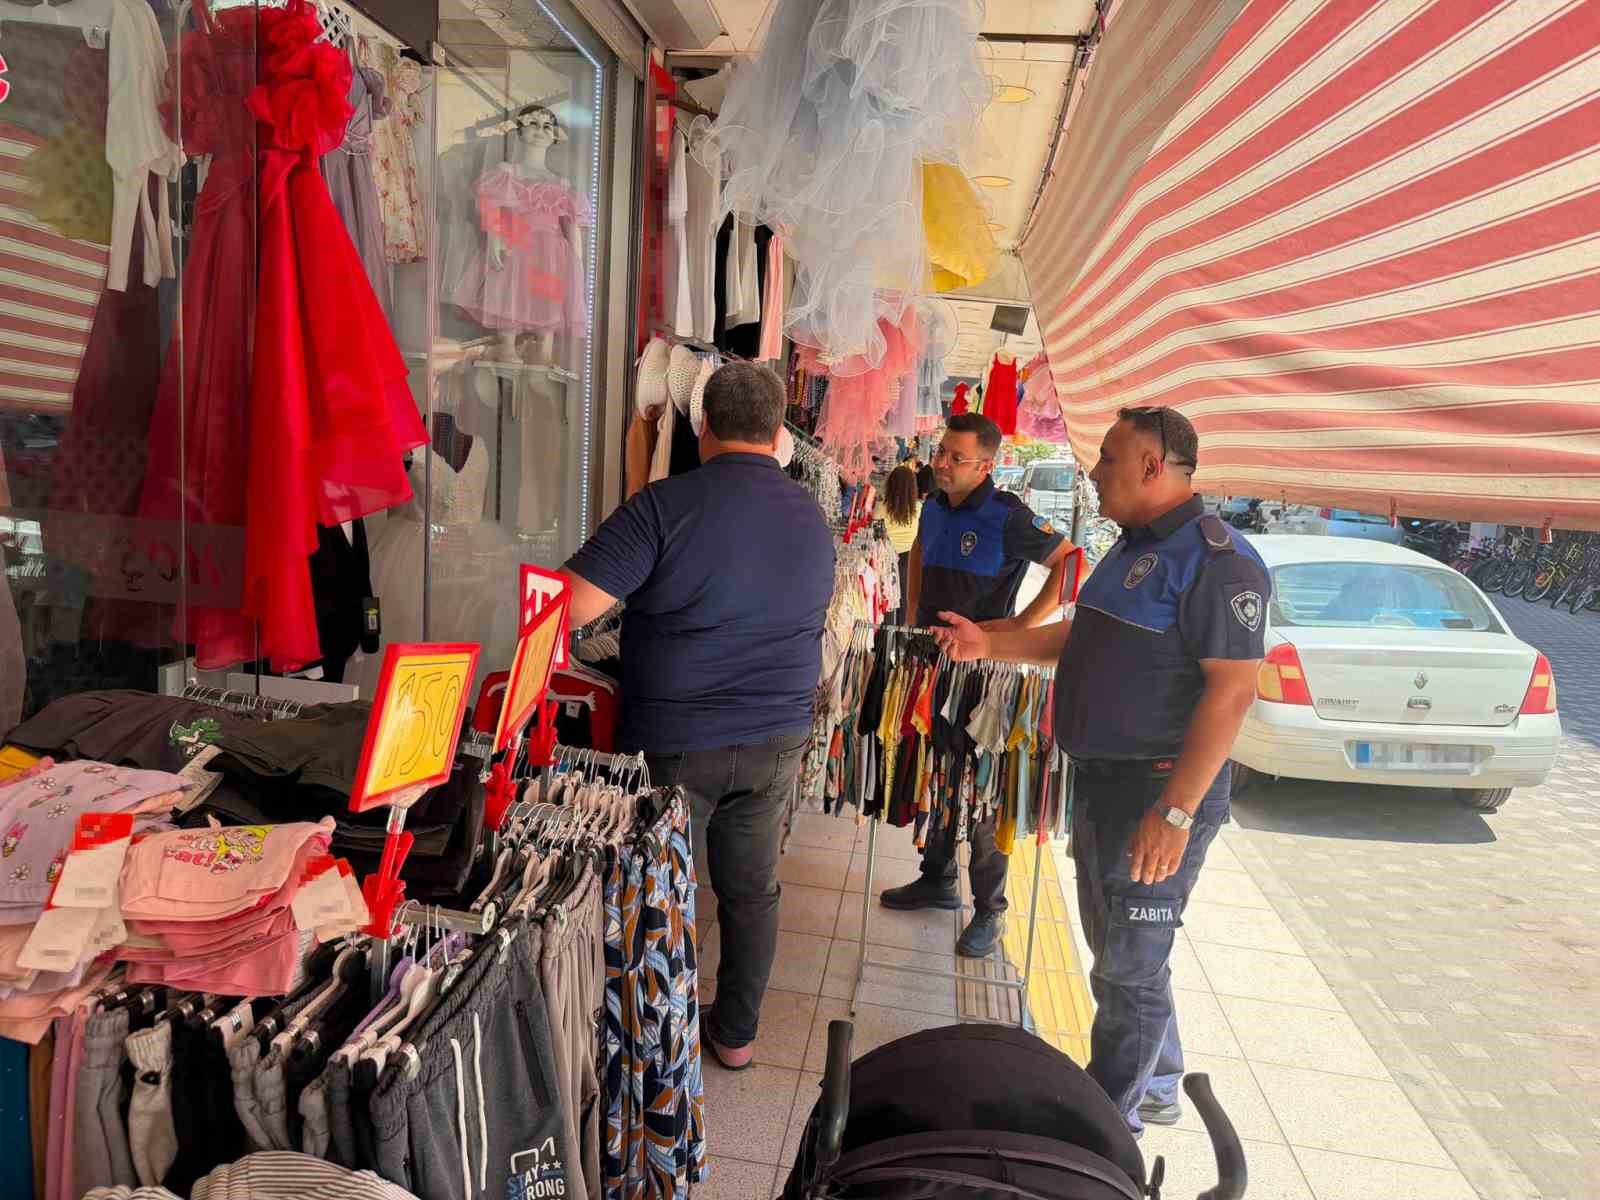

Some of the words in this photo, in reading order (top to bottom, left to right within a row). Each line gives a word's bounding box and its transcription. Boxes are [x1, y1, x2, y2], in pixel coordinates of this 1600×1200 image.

[384, 671, 461, 779] 150
[1128, 907, 1174, 921] ZABITA
[510, 1178, 566, 1200] TRONG
